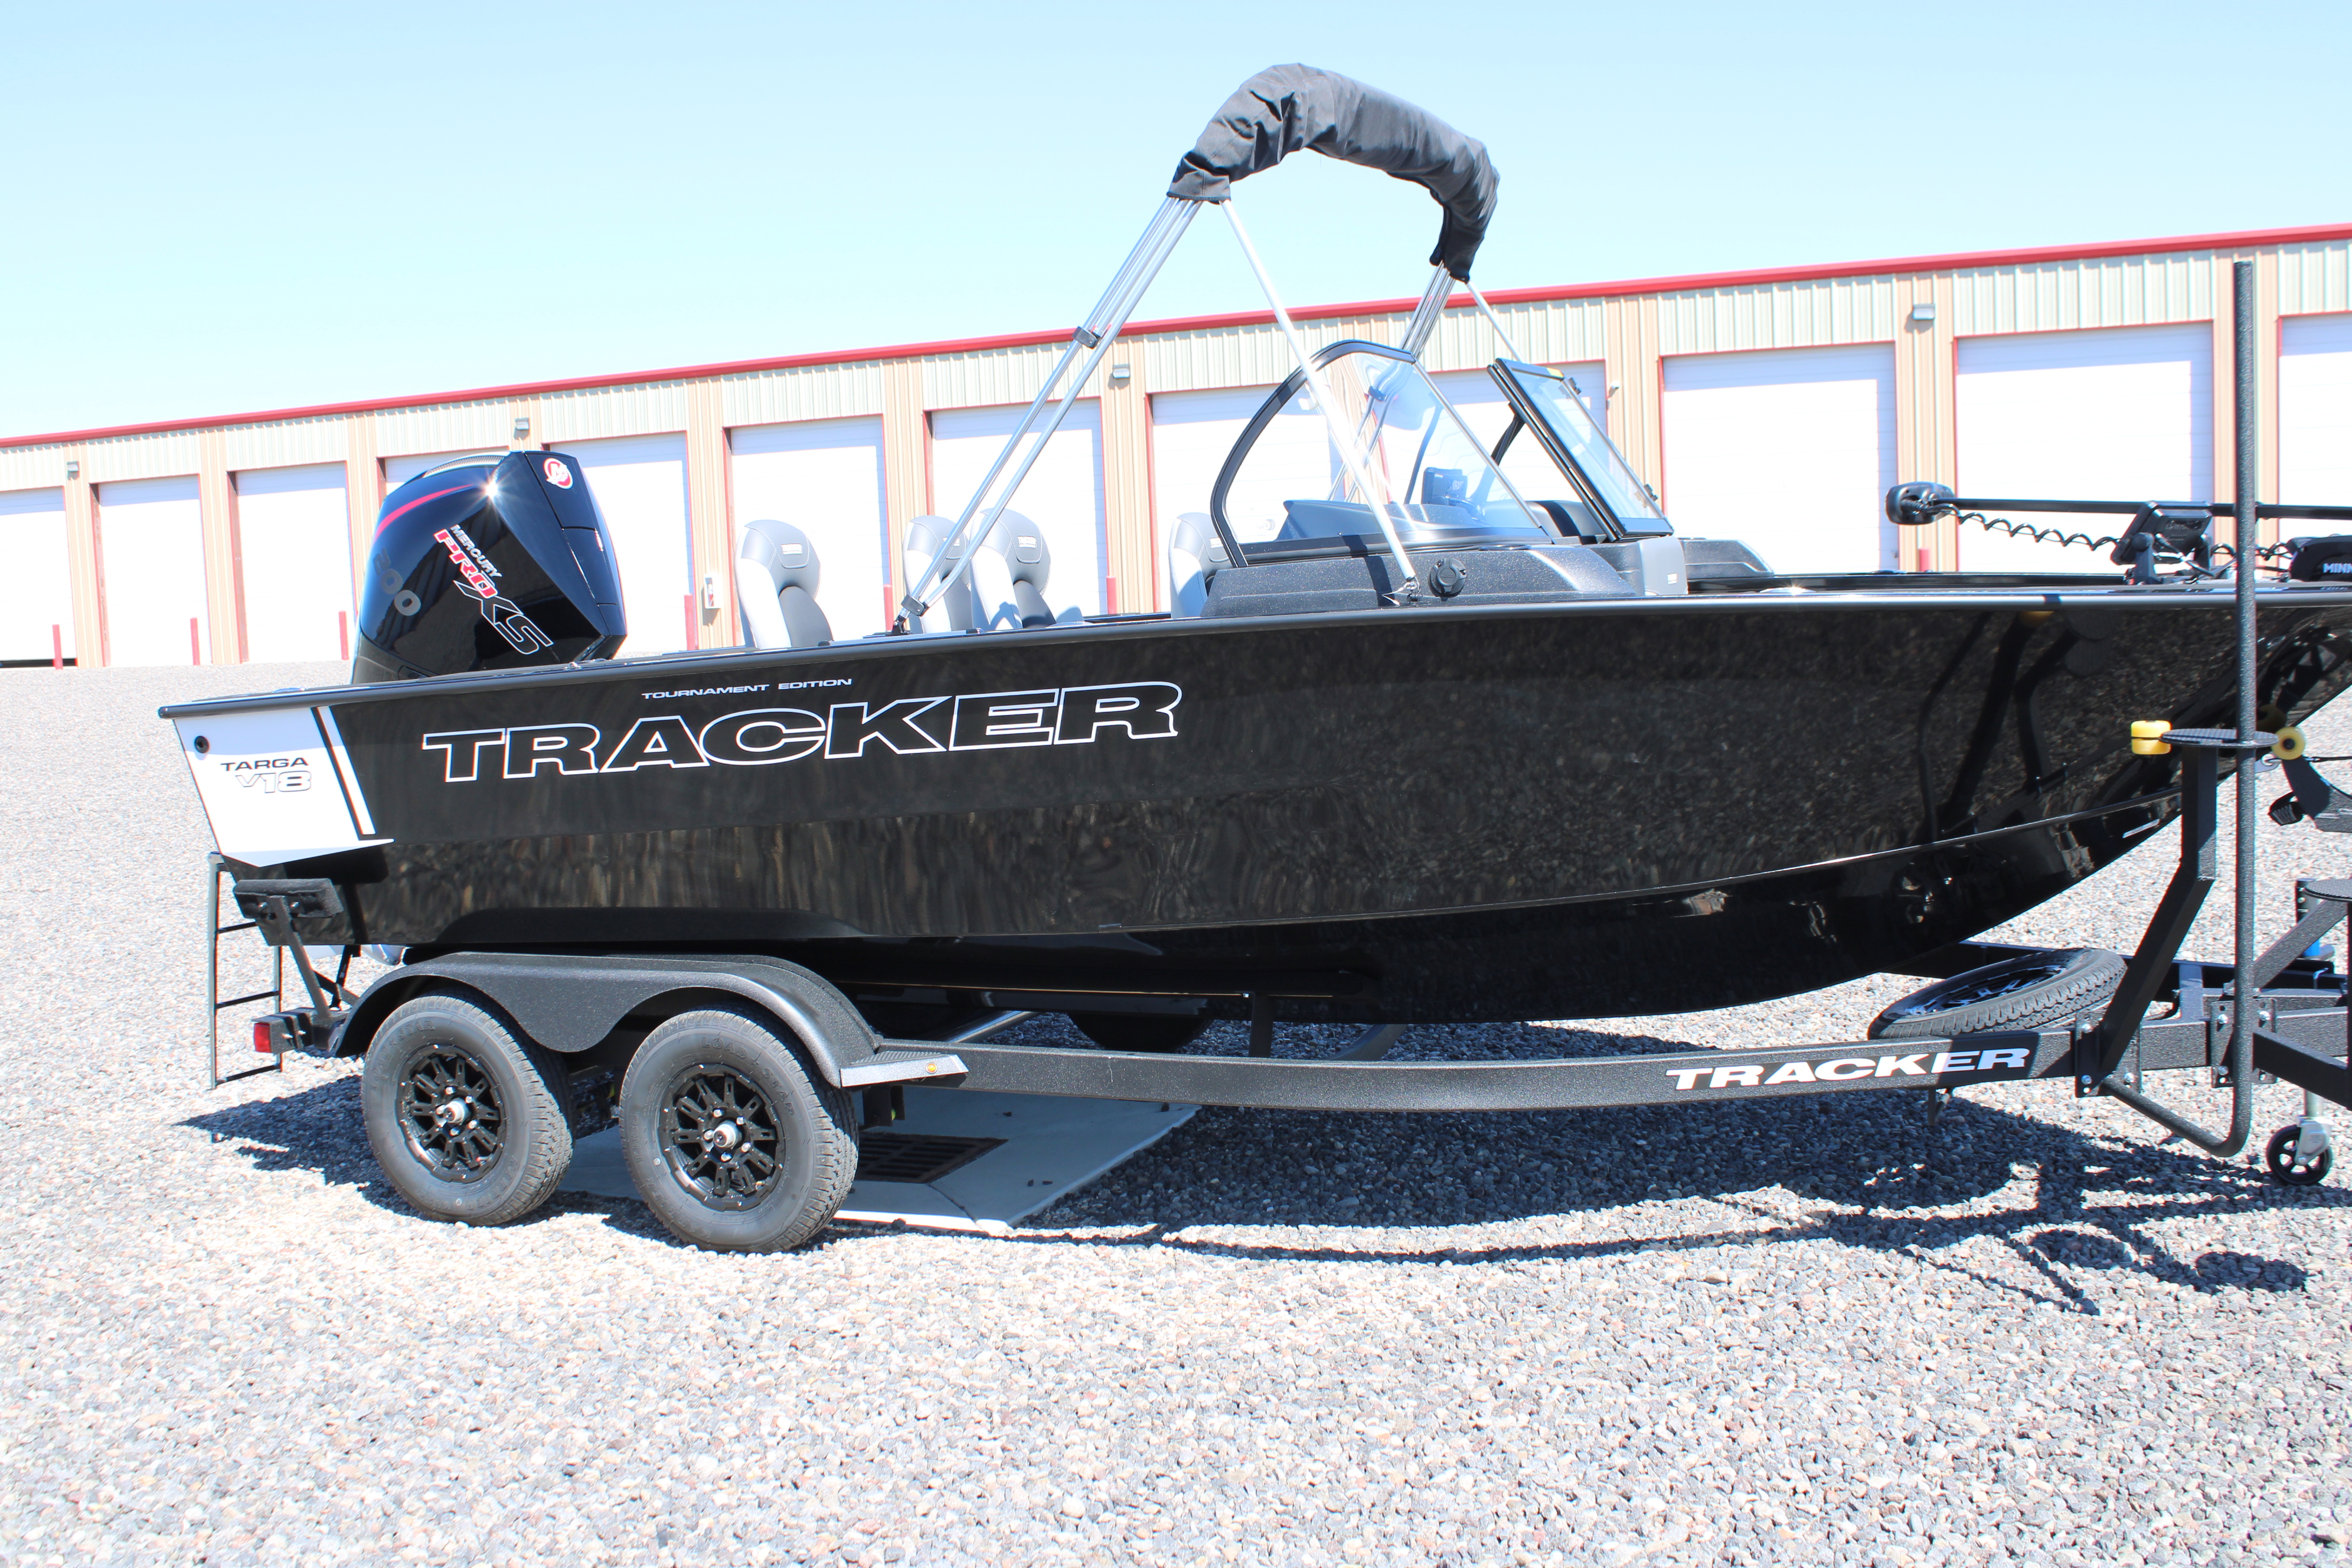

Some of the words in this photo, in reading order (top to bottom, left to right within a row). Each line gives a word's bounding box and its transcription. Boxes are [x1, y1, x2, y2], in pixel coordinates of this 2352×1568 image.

[373, 547, 421, 616] 200
[433, 529, 498, 599] PRO
[450, 524, 502, 578] MERCURY
[453, 580, 554, 655] XS
[642, 684, 769, 699] TOURNAMENT
[778, 678, 852, 691] EDITION
[220, 757, 309, 772] TARGA
[422, 681, 1182, 783] TRACKER
[236, 770, 311, 793] V18
[370, 1047, 389, 1091] LOAD
[398, 1021, 436, 1041] STAR
[701, 1036, 748, 1059] LOAD
[762, 1068, 796, 1115] STAR
[1665, 1048, 2030, 1090] TRACKER
